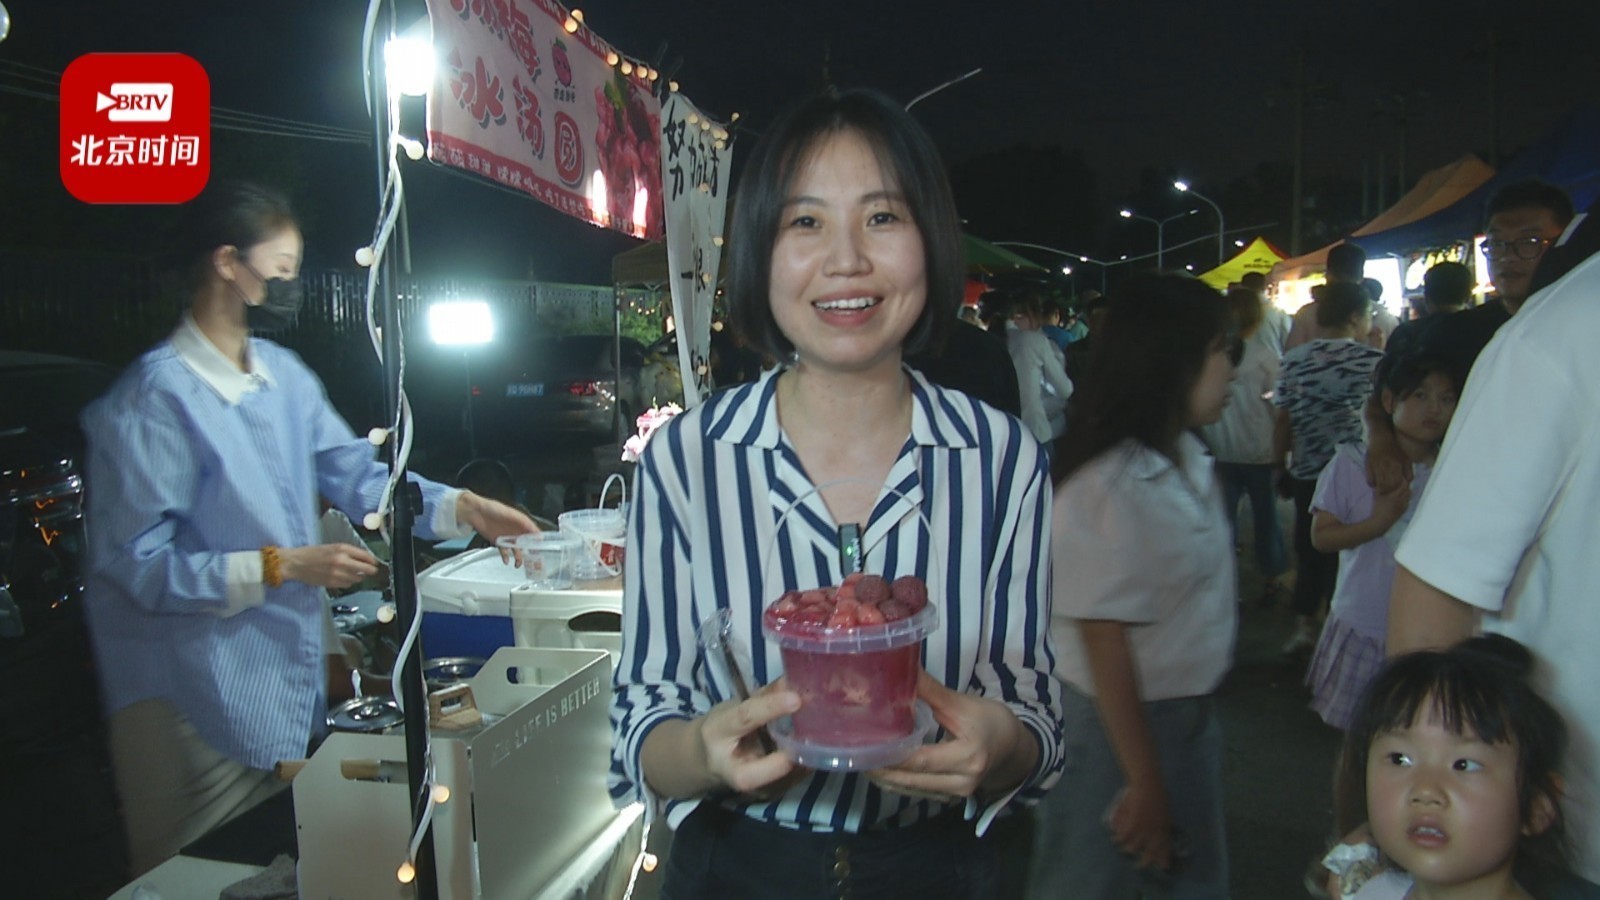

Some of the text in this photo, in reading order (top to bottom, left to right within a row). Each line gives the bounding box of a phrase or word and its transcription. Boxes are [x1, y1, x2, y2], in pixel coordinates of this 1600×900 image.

[447, 50, 584, 186] 冰汤圆
[546, 704, 557, 727] IS
[561, 677, 600, 717] BETTER
